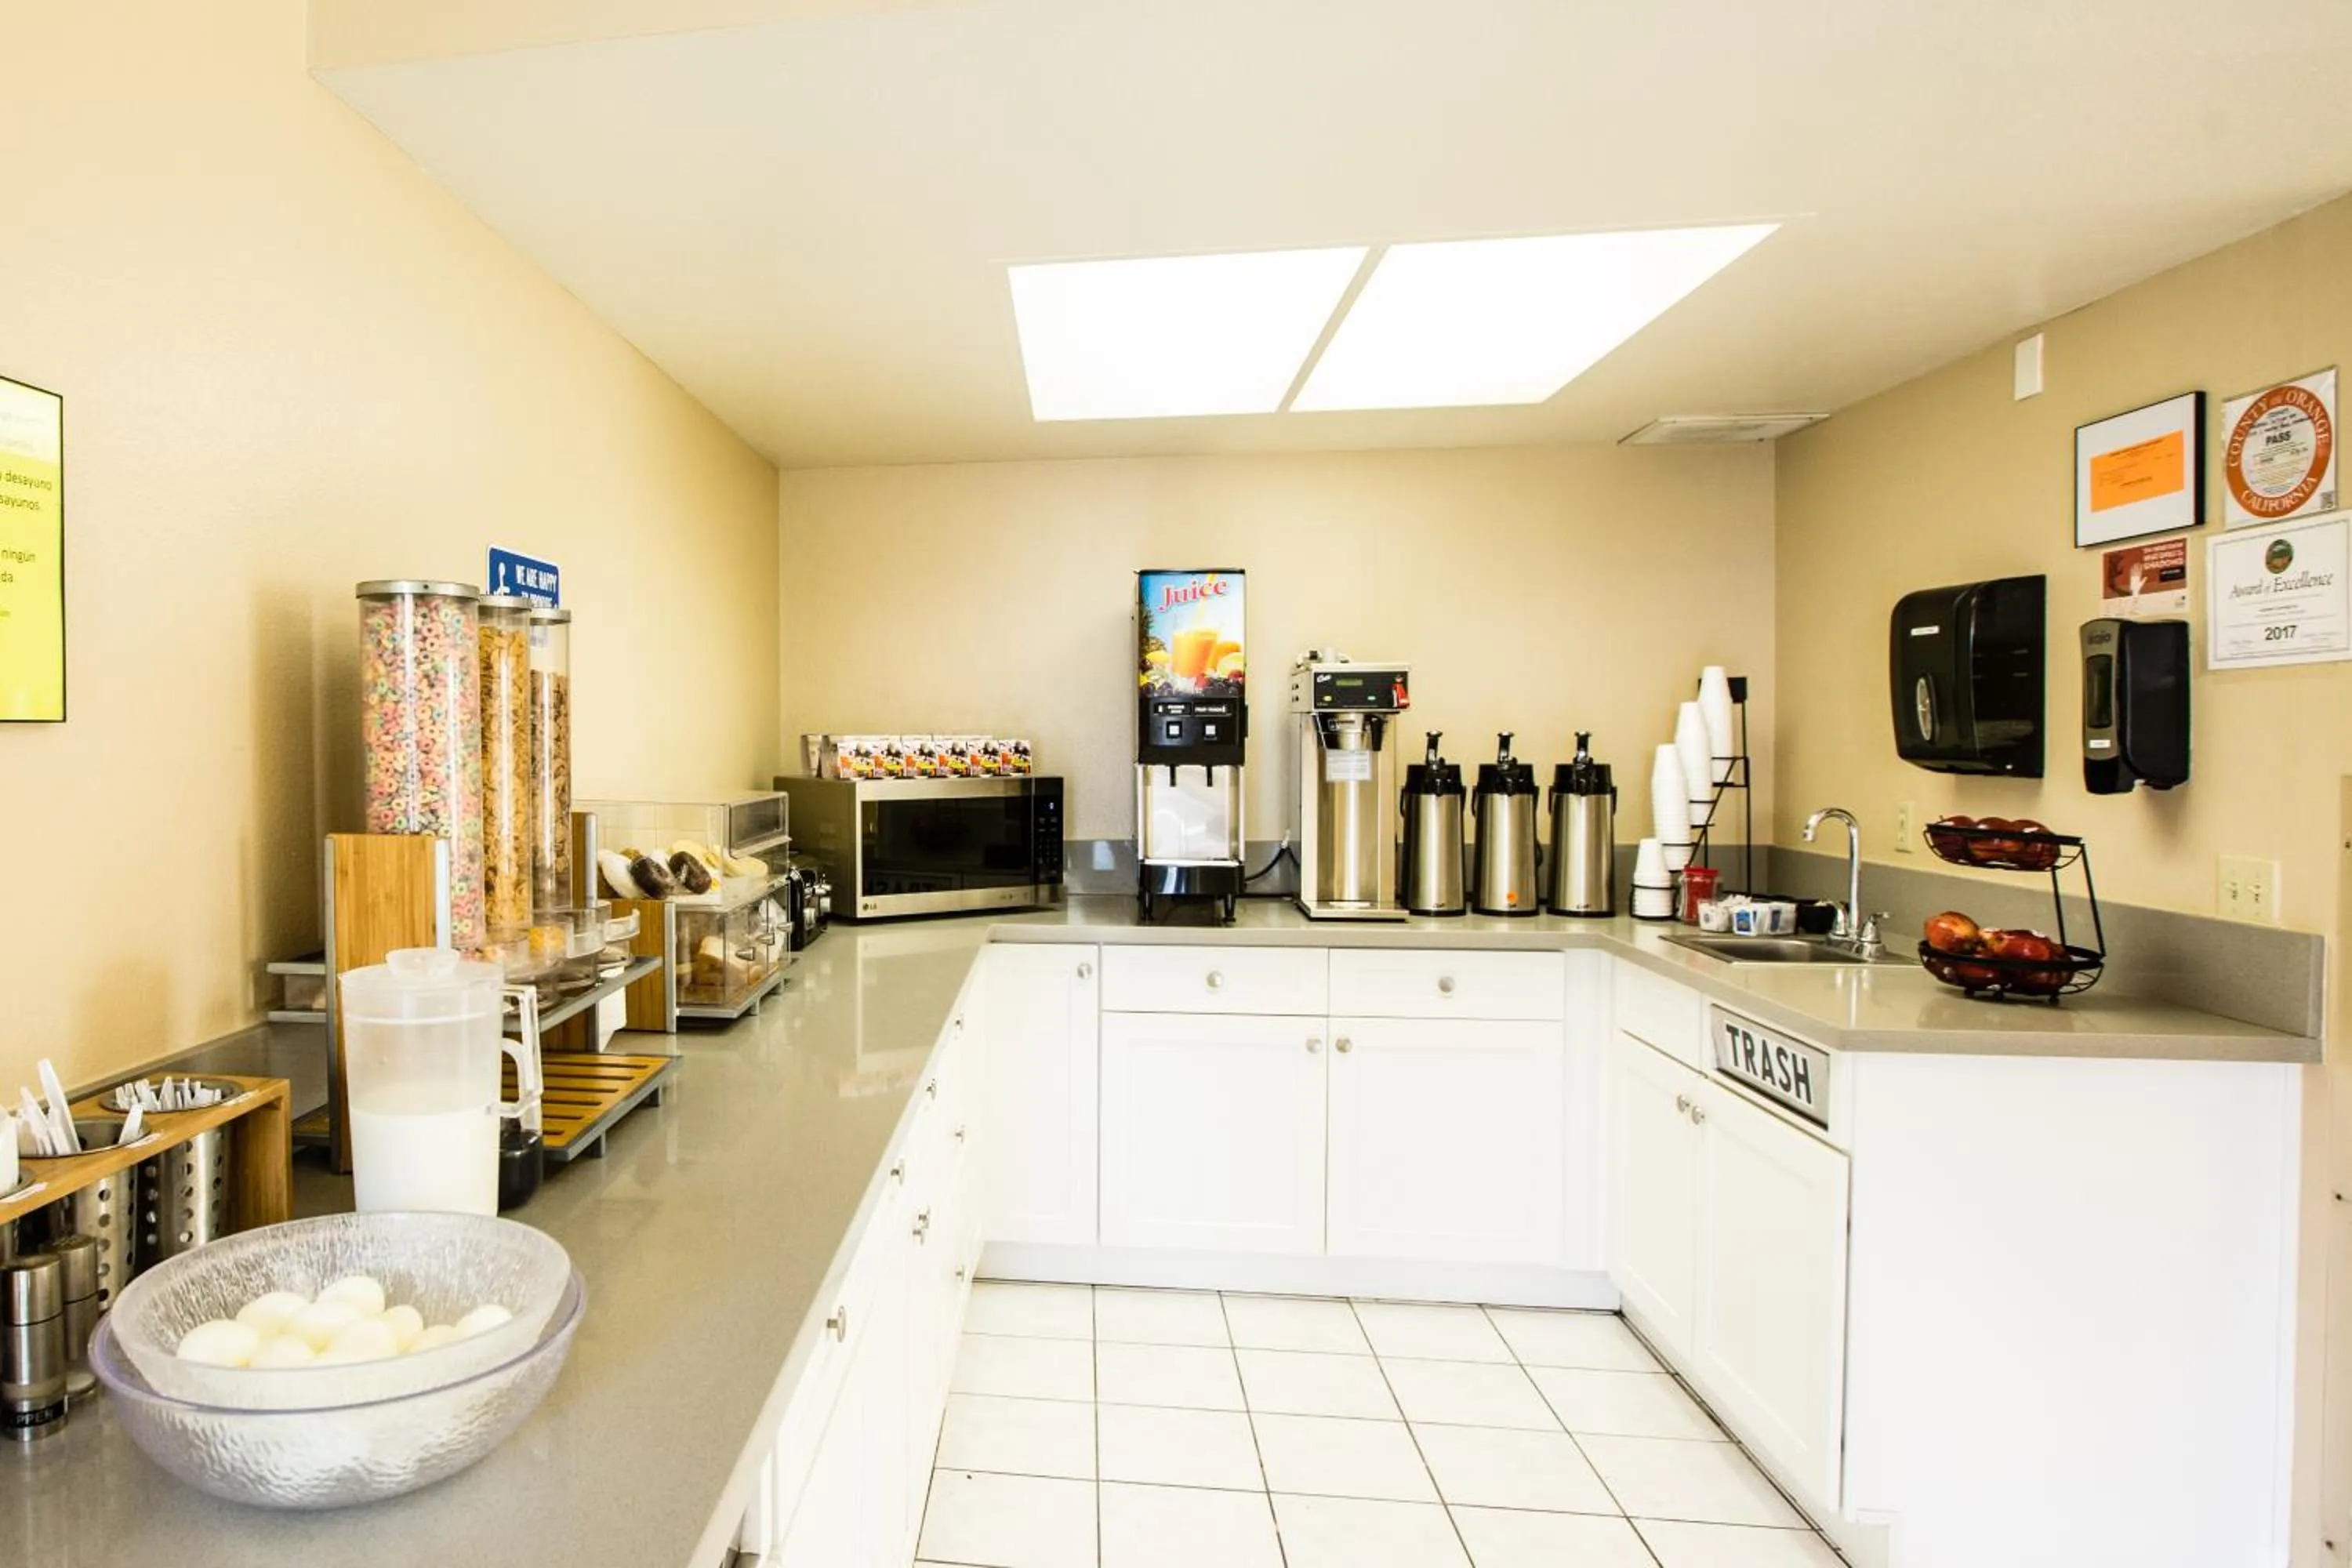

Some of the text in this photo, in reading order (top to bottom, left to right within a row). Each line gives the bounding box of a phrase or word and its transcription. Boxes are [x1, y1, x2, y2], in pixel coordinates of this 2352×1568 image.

[2228, 391, 2330, 467] COUNTY ORANGE
[2266, 430, 2292, 445] PASS
[4, 470, 53, 492] desayuno
[2240, 477, 2318, 513] CALIFORNIA
[2273, 571, 2334, 593] Excellence
[1158, 580, 1228, 612] Juice
[2264, 625, 2299, 641] 2017
[1726, 1024, 1812, 1105] TRASH
